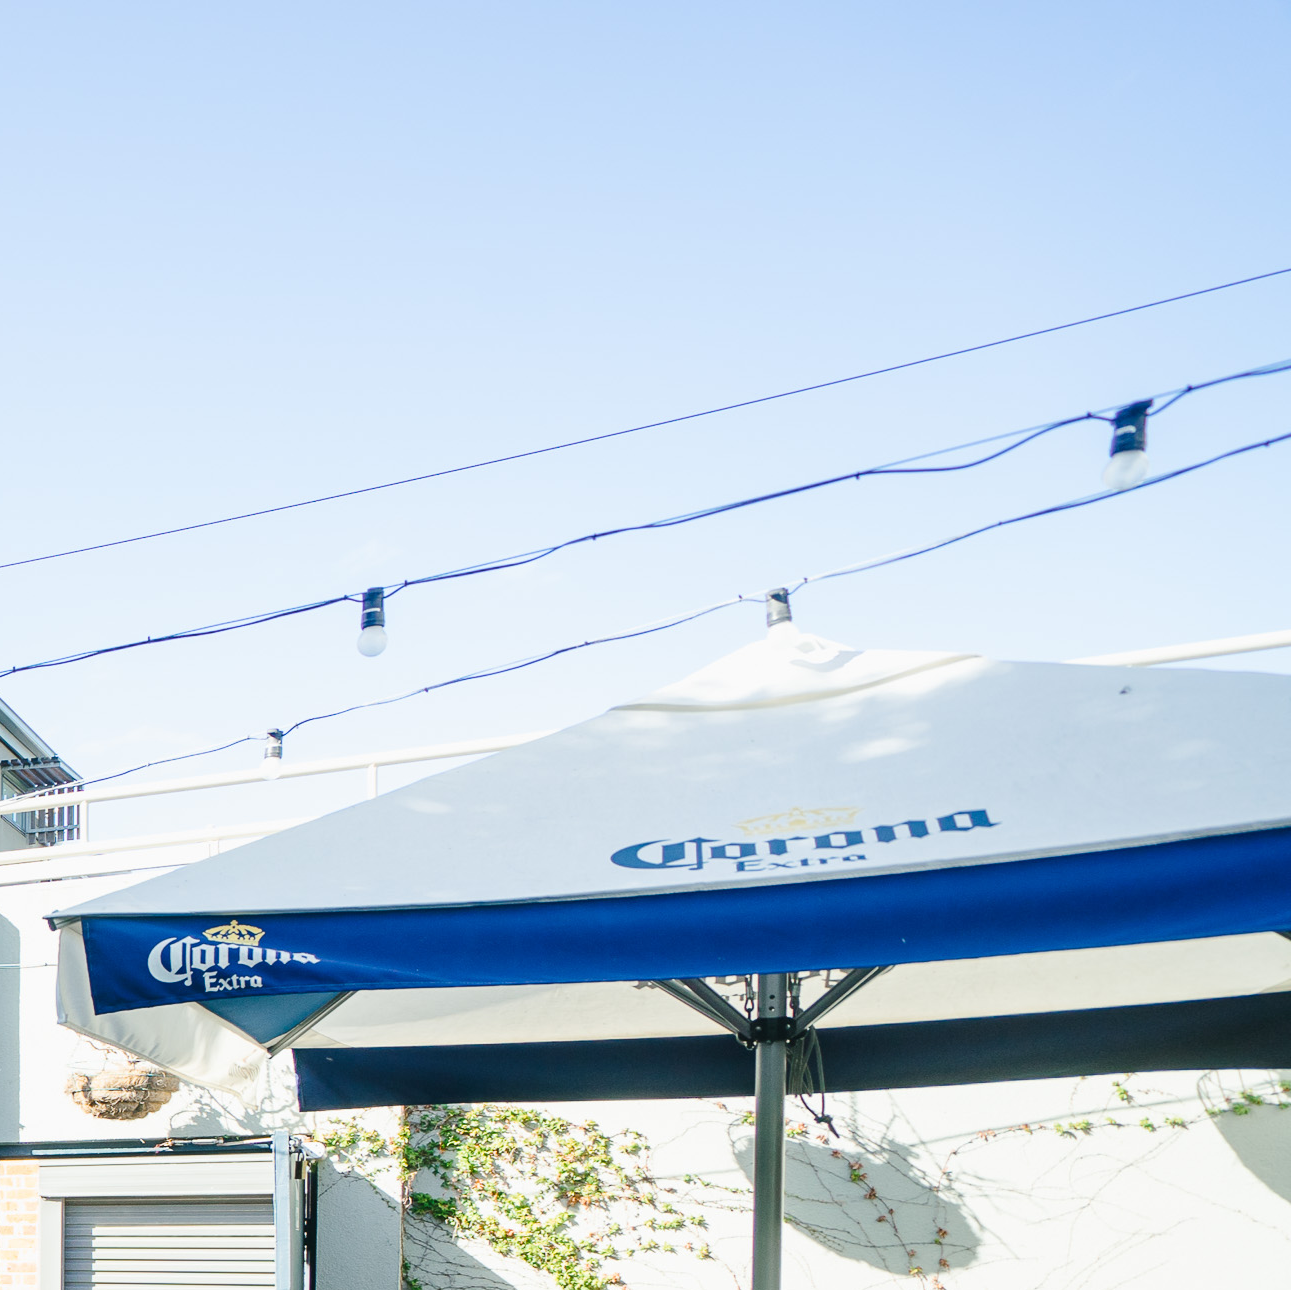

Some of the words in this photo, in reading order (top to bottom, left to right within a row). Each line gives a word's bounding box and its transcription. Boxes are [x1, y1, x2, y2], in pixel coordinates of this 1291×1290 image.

[610, 809, 1001, 871] Corona
[735, 854, 868, 872] Extra
[147, 936, 321, 986] Corona
[202, 970, 263, 992] Extra
